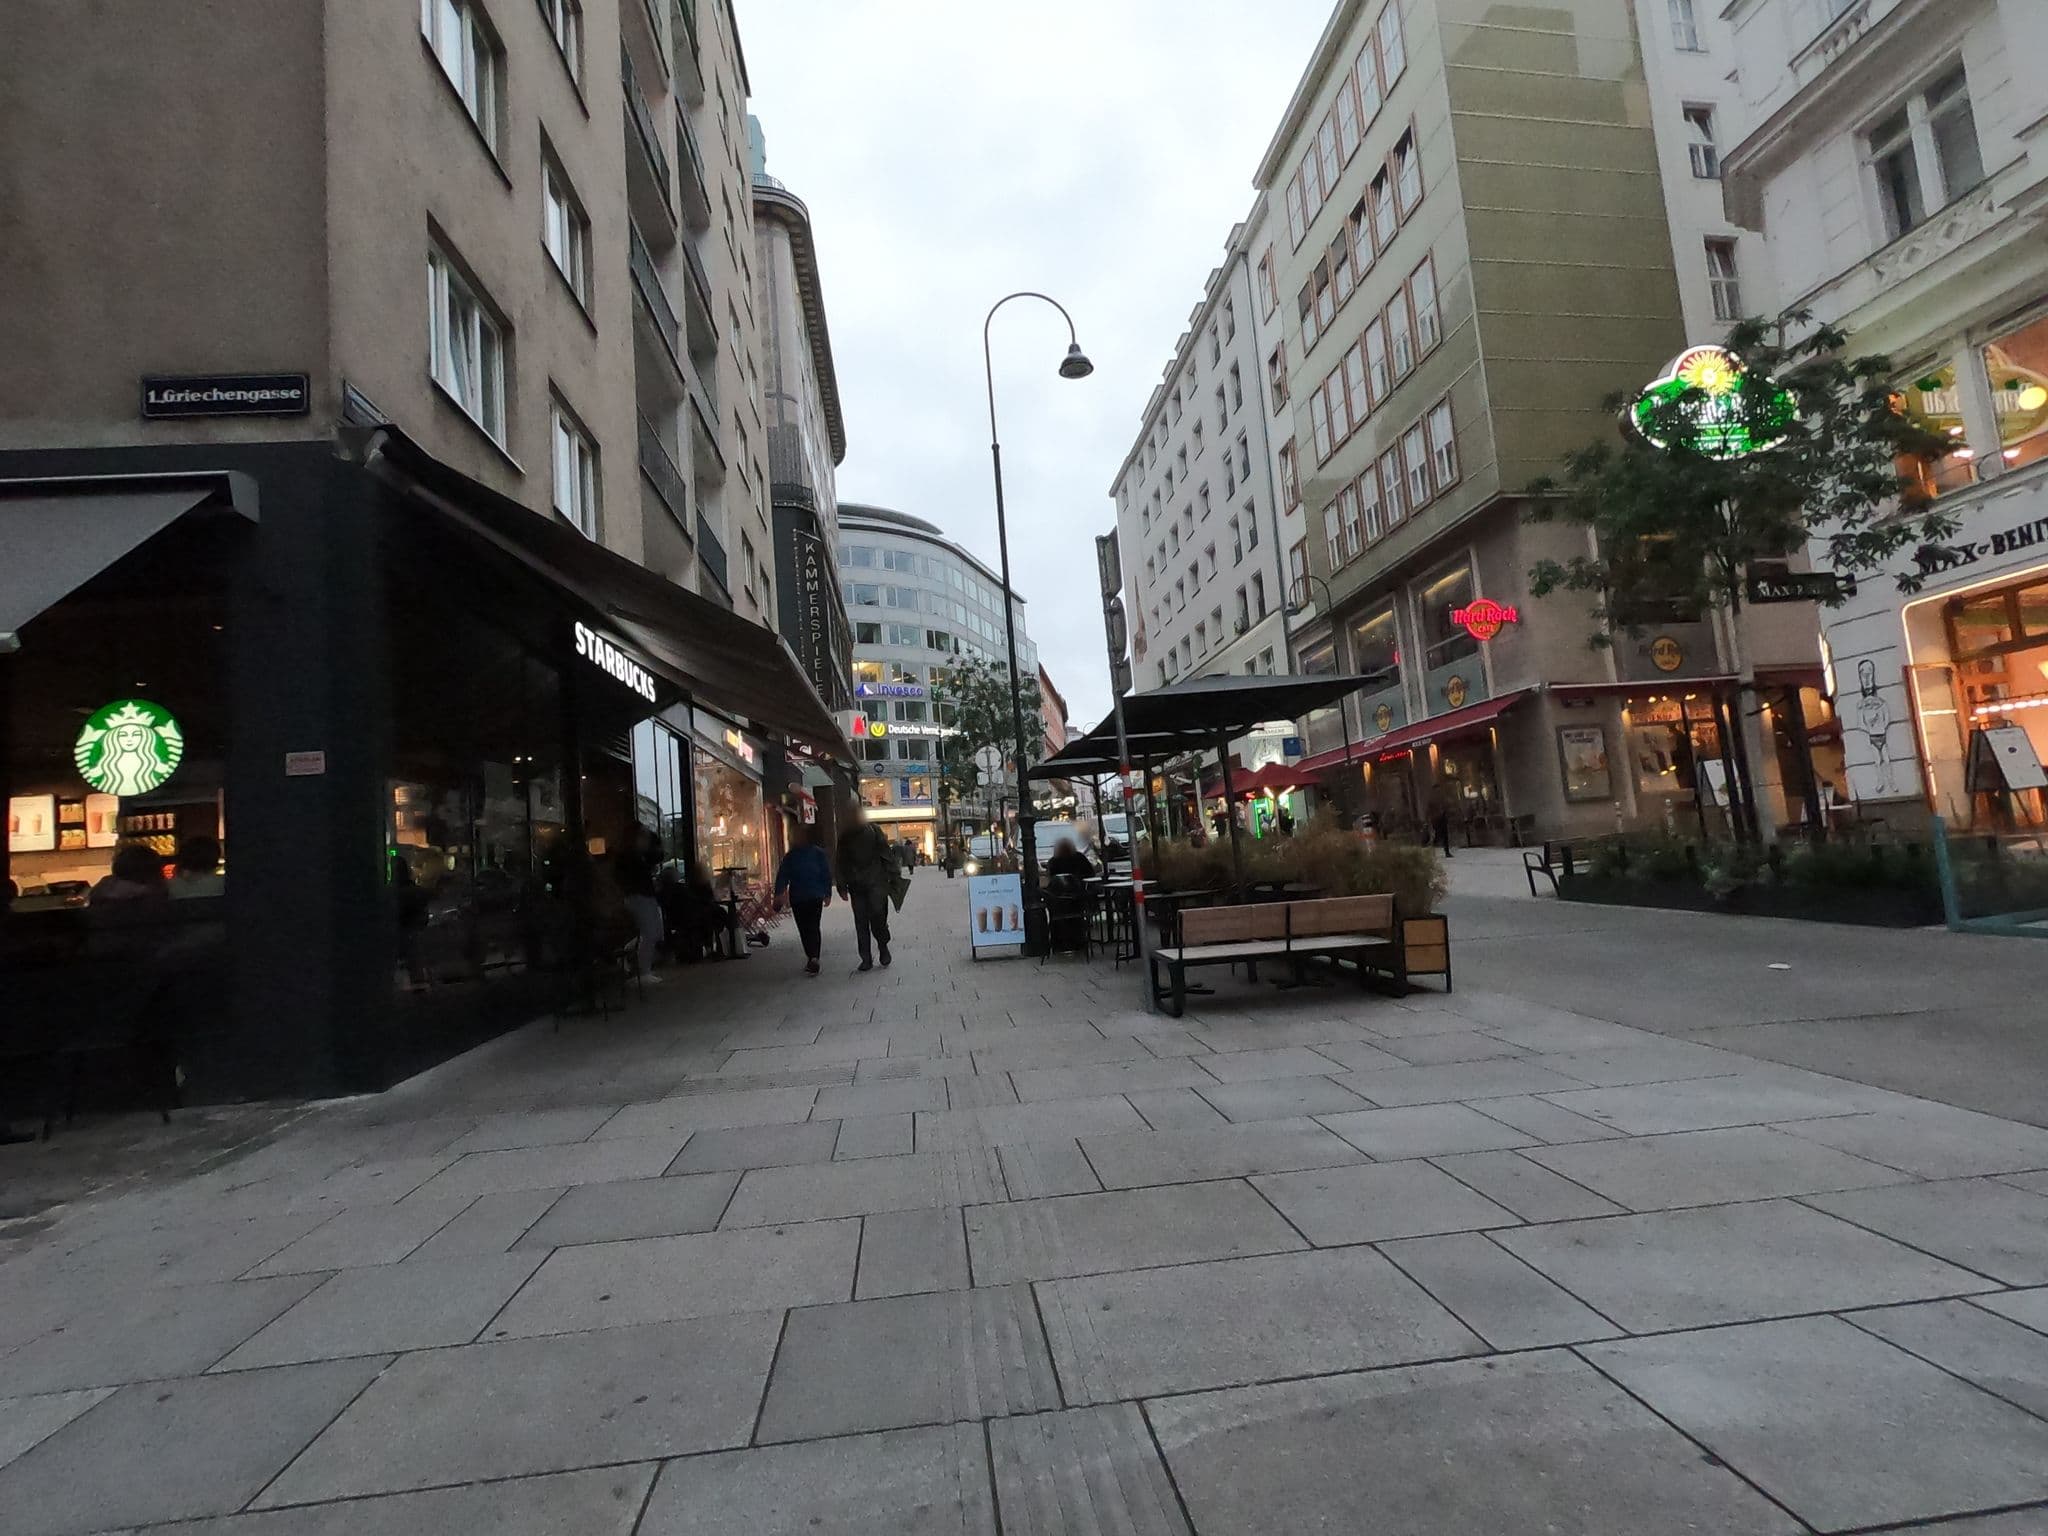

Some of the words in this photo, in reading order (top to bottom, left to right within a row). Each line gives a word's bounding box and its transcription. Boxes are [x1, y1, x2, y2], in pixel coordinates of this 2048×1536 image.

[804, 542, 825, 696] KAMMERSPIELE
[1453, 608, 1485, 624] Hard
[1486, 606, 1518, 624] Rock
[575, 621, 656, 703] STARBUCKS
[876, 683, 923, 697] Invesco
[888, 724, 920, 735] Deutsche
